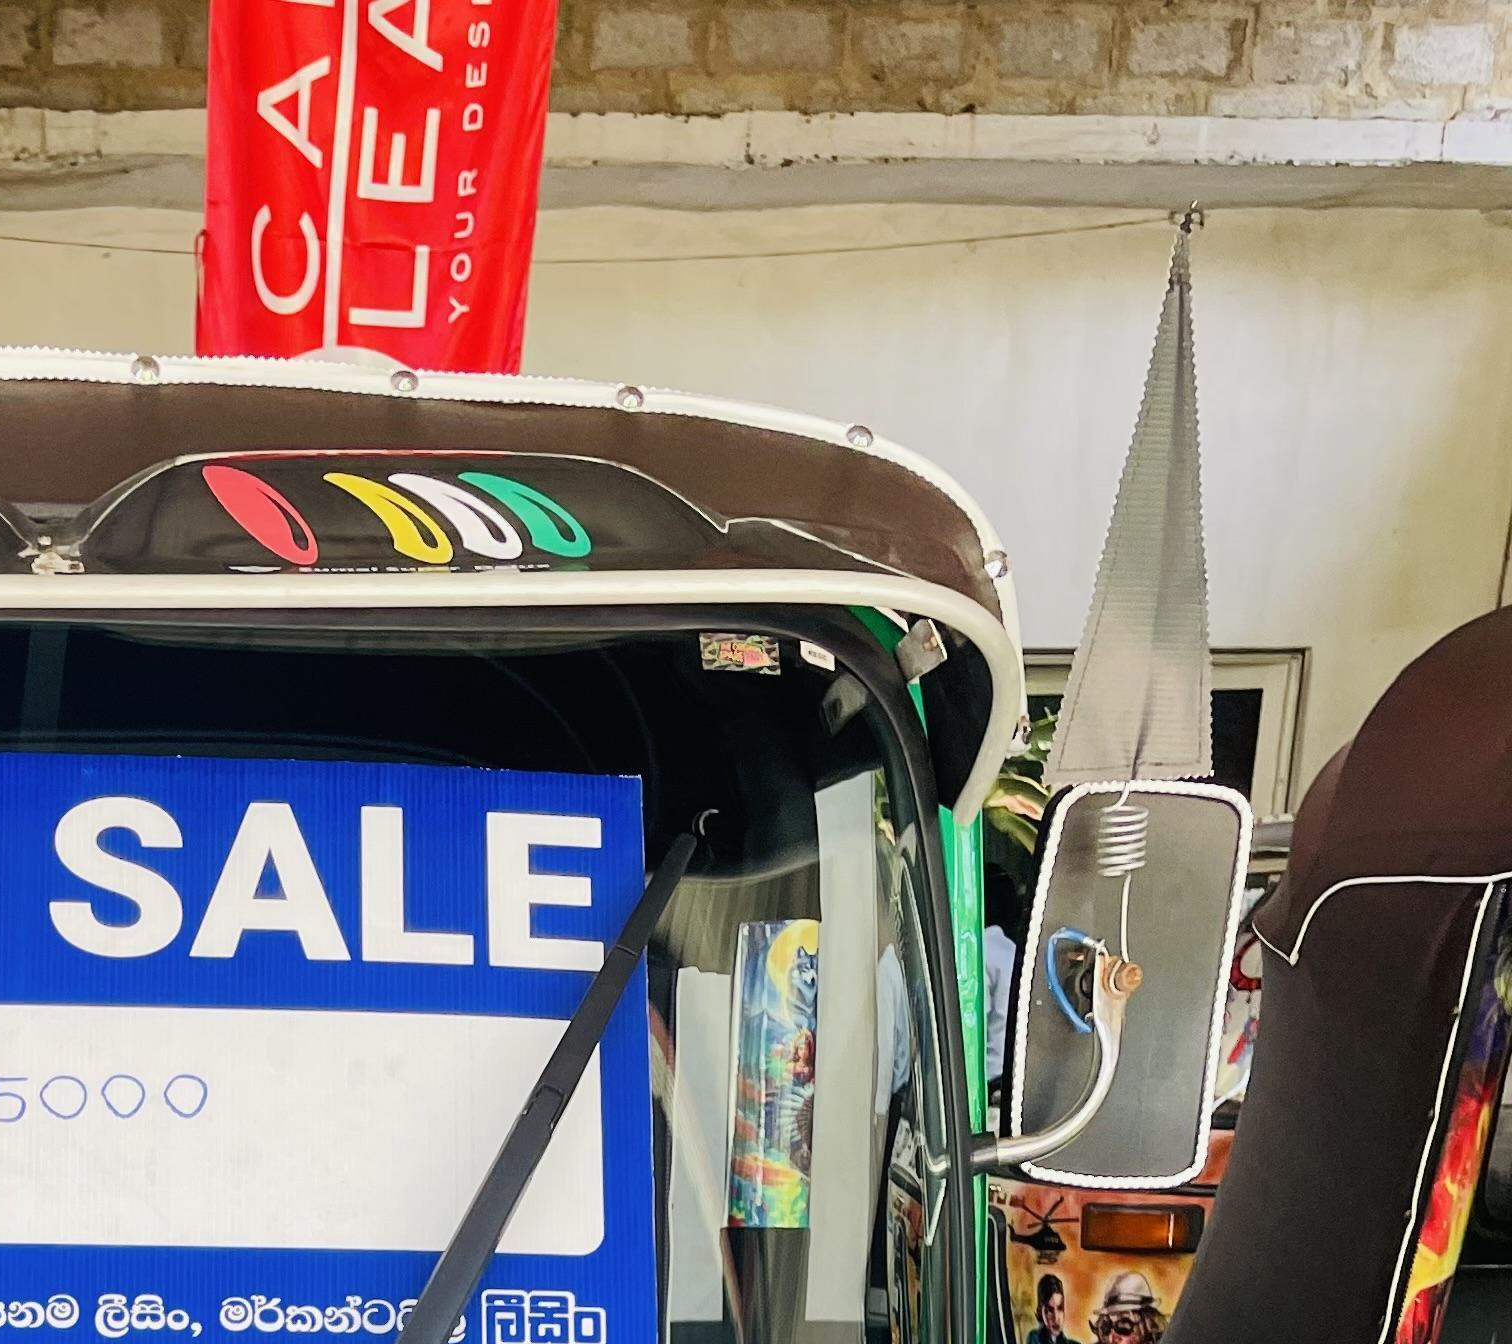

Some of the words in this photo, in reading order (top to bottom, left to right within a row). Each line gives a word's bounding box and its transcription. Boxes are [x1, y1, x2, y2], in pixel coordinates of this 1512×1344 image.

[463, 0, 492, 131] DES
[251, 0, 335, 315] CA
[448, 168, 479, 324] YOUR
[48, 795, 606, 972] SALE
[94, 1293, 203, 1338] ලීසිං,
